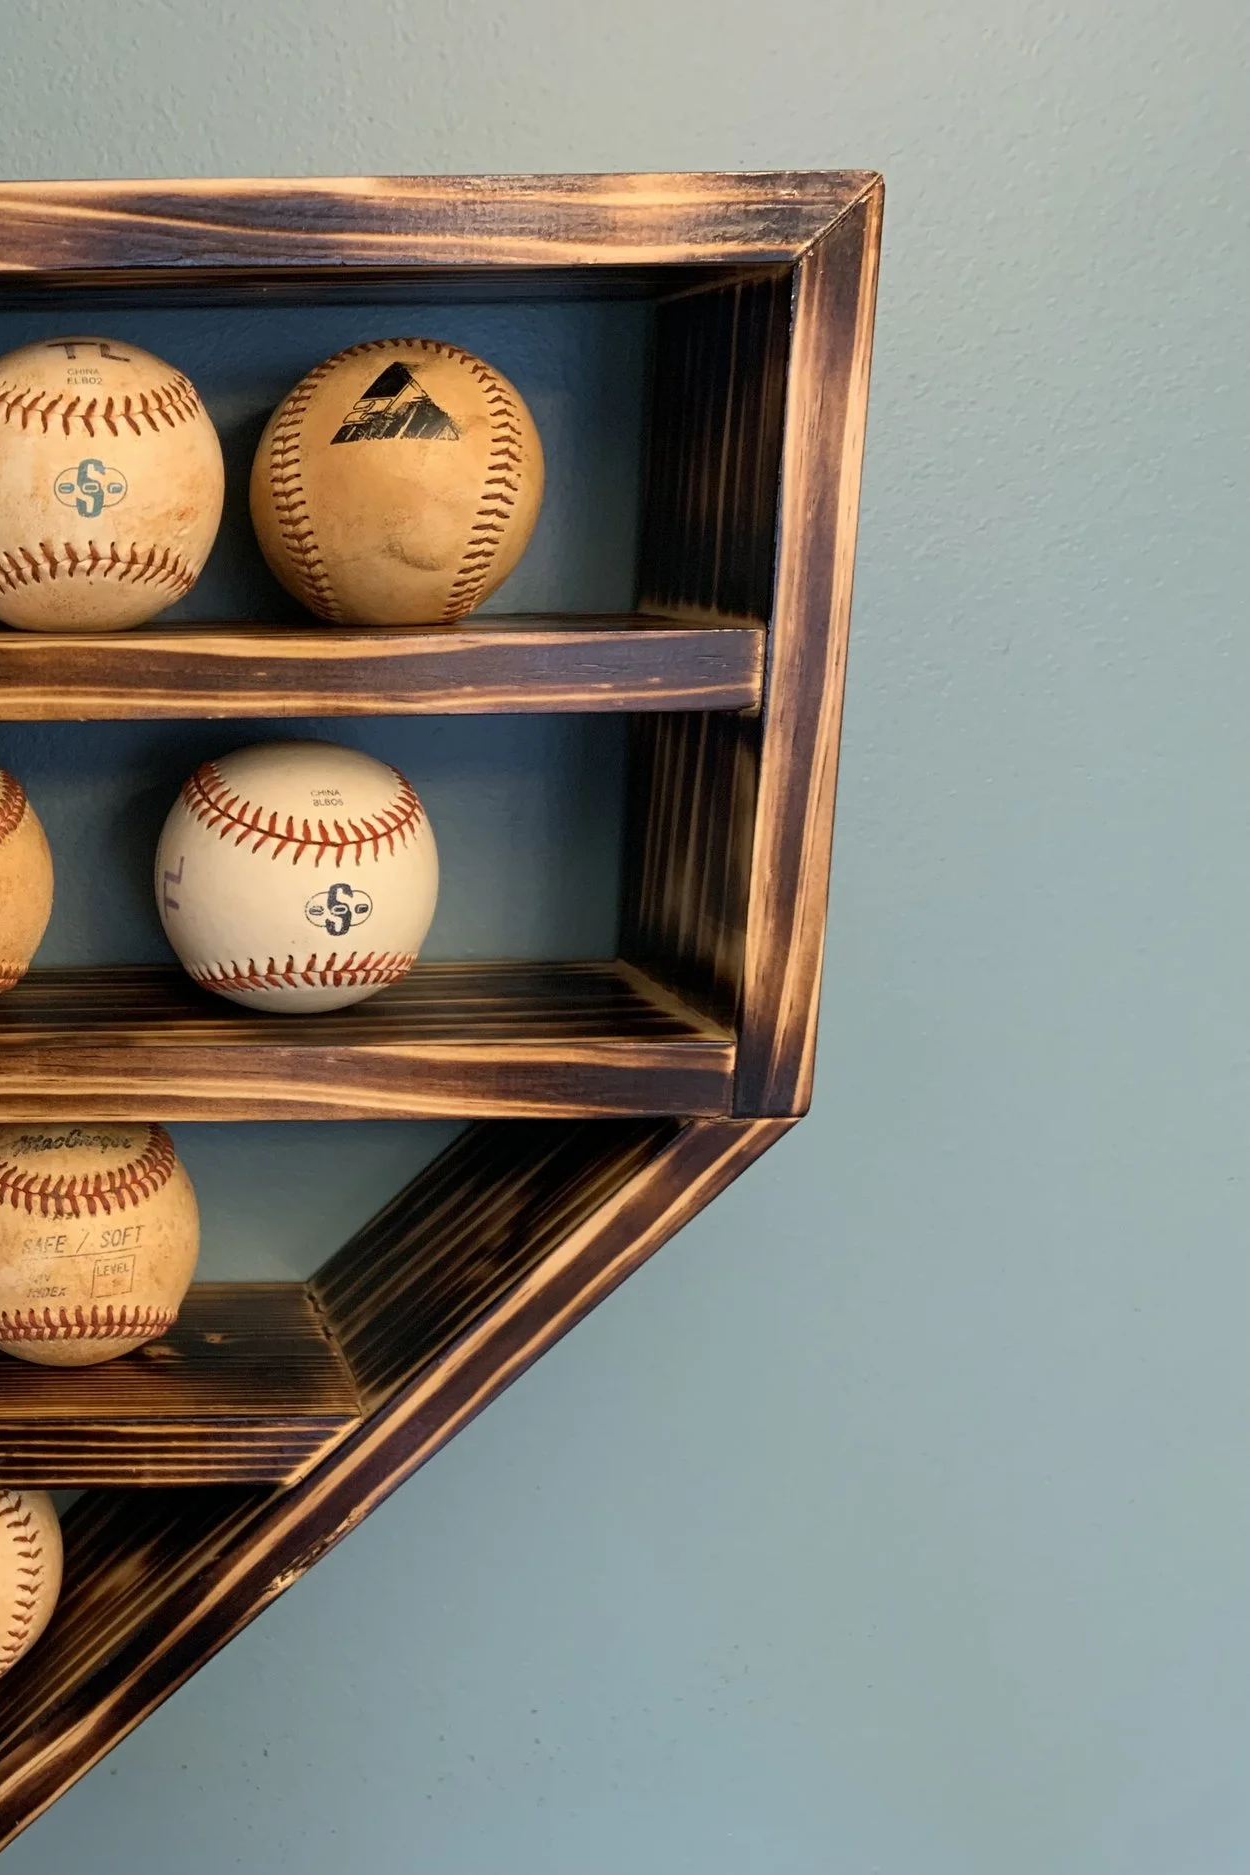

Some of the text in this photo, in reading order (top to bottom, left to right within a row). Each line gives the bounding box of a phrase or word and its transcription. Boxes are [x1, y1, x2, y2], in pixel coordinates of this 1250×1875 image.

[67, 368, 100, 376] CHINA
[310, 789, 342, 797] CHINA
[21, 1235, 67, 1255] SAFE
[100, 1225, 146, 1249] SOFT
[96, 1262, 130, 1278] LEVEL
